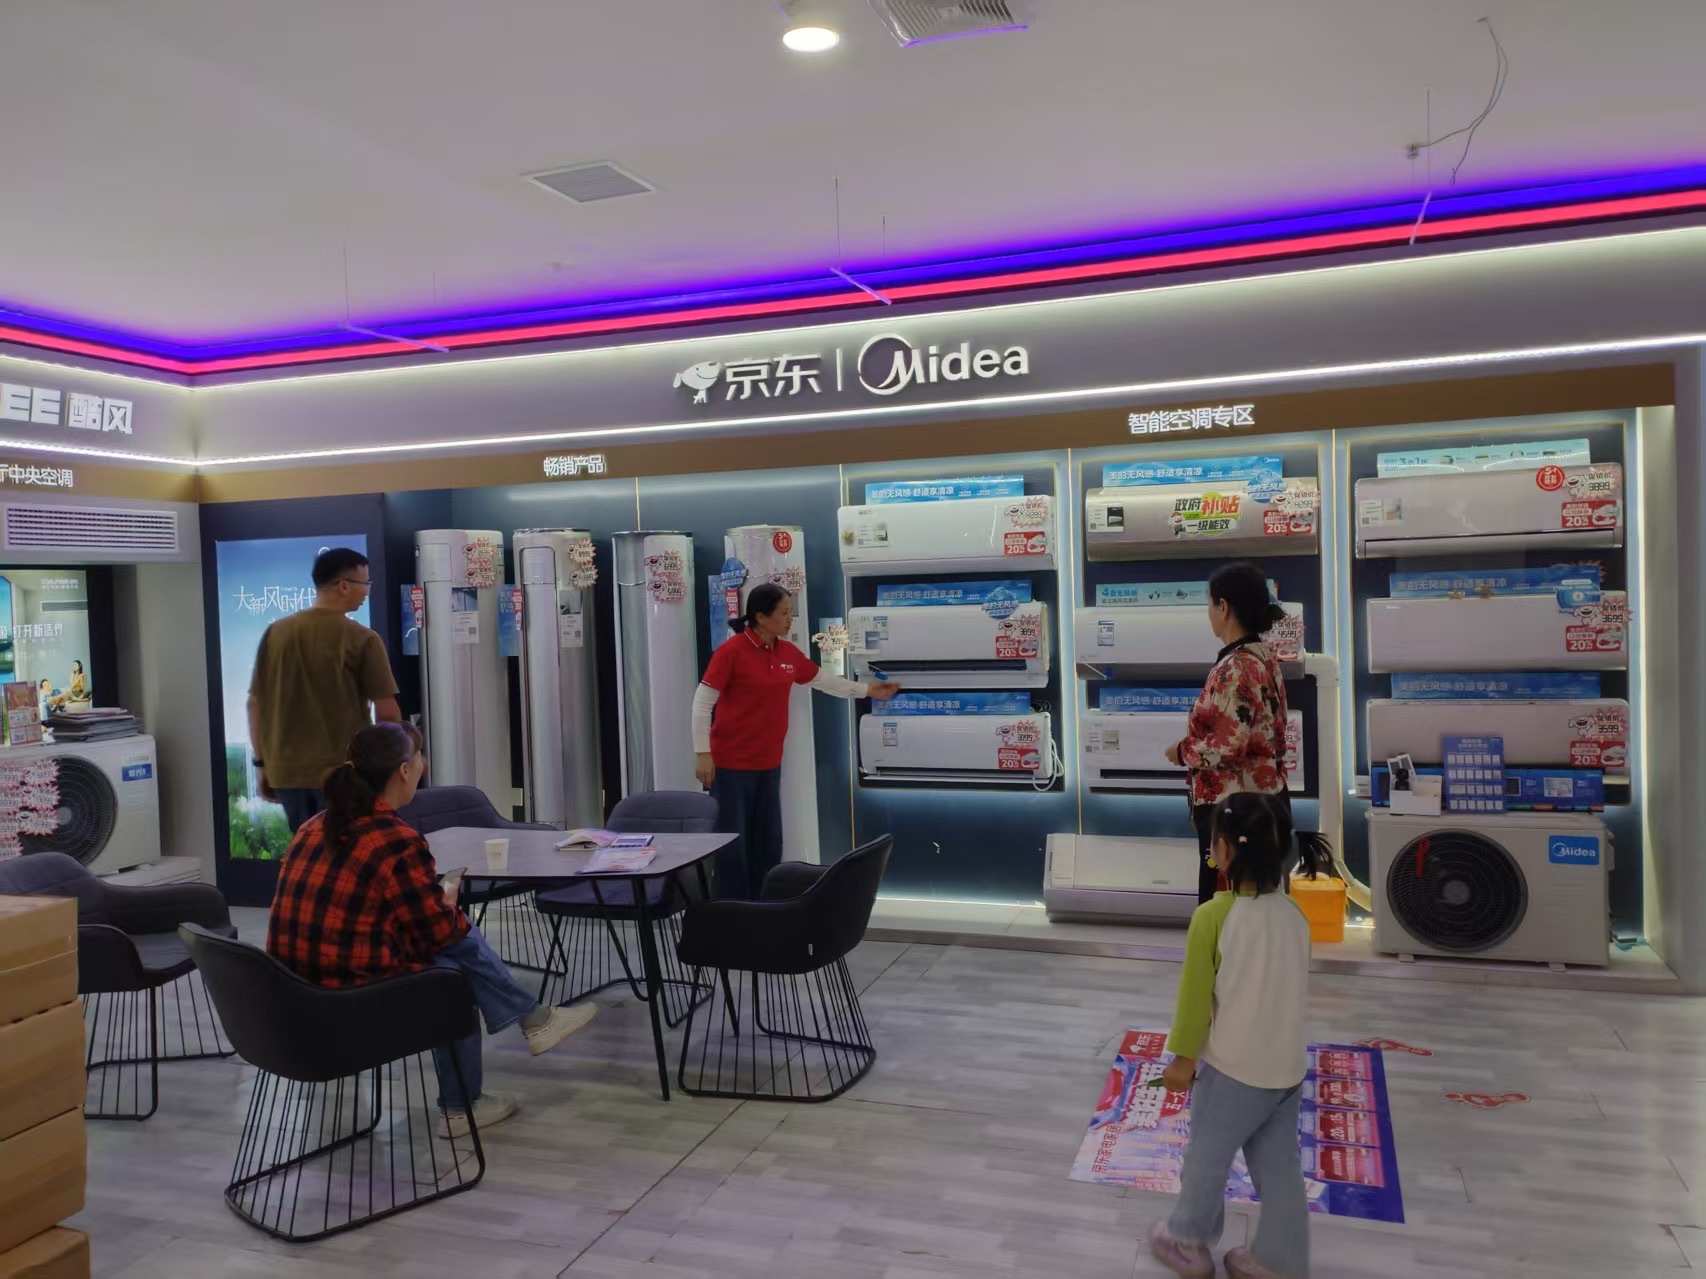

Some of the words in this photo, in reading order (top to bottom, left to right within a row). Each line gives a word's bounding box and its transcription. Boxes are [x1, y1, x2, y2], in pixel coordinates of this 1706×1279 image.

[724, 353, 822, 400] 京东
[858, 332, 1030, 395] Midea
[67, 392, 133, 434] 酷风
[1128, 404, 1256, 434] 智能空调专区
[543, 454, 604, 477] 畅销产品
[1174, 495, 1240, 515] 政府补贴
[1187, 519, 1231, 531] 一级能效
[1551, 842, 1596, 857] Midea
